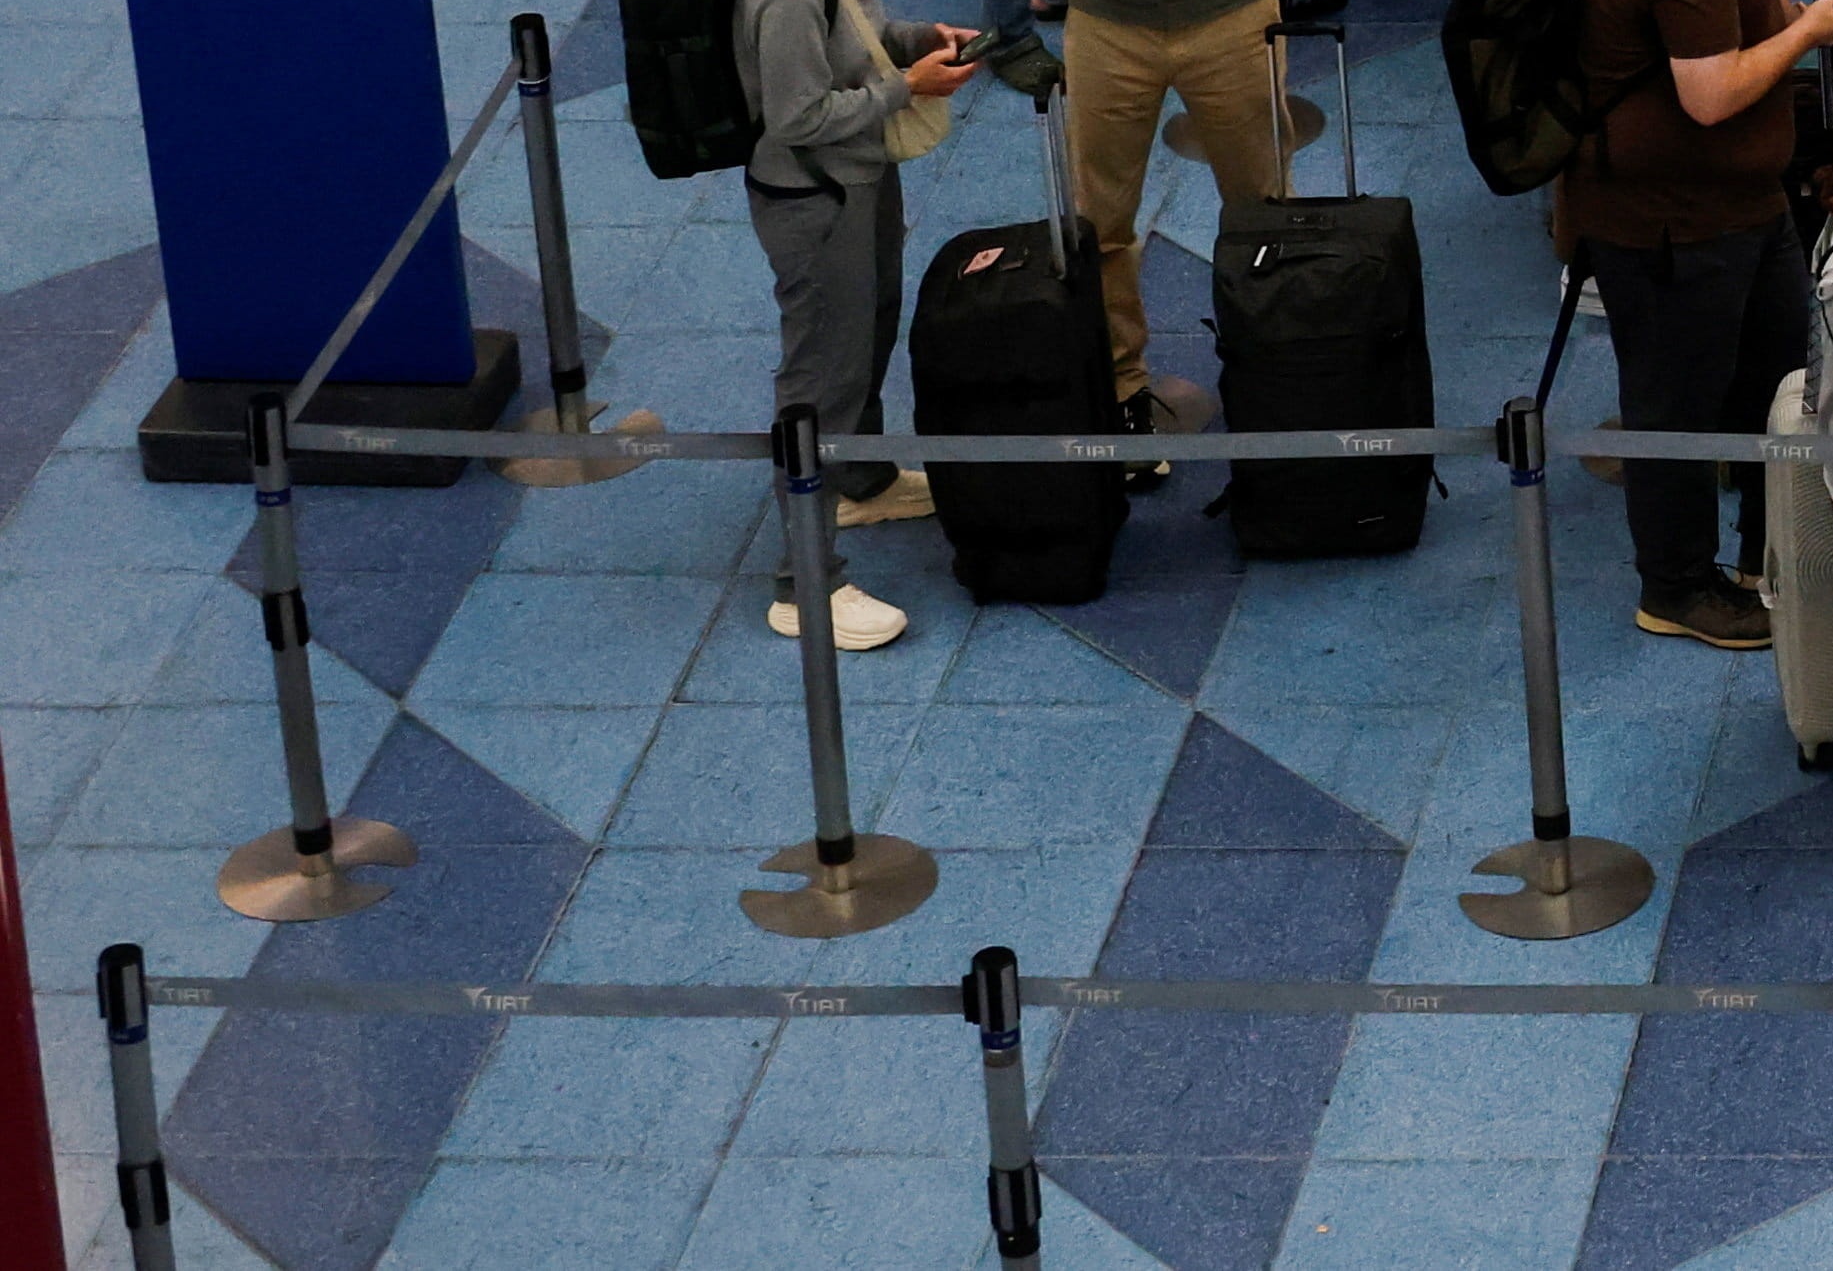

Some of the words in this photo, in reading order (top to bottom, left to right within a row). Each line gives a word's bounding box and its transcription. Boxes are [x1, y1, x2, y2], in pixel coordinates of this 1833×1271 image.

[353, 437, 397, 450] TIAT
[630, 443, 673, 456] TIAT
[1351, 439, 1394, 452] TIAT
[1073, 445, 1117, 458] TIAT
[1769, 445, 1814, 459] TIAT
[1075, 989, 1123, 1003] TIAT
[1394, 996, 1440, 1009] TIAT
[1711, 995, 1758, 1008] TIAT
[481, 995, 533, 1011] TIAT
[799, 999, 847, 1013] TIAT
